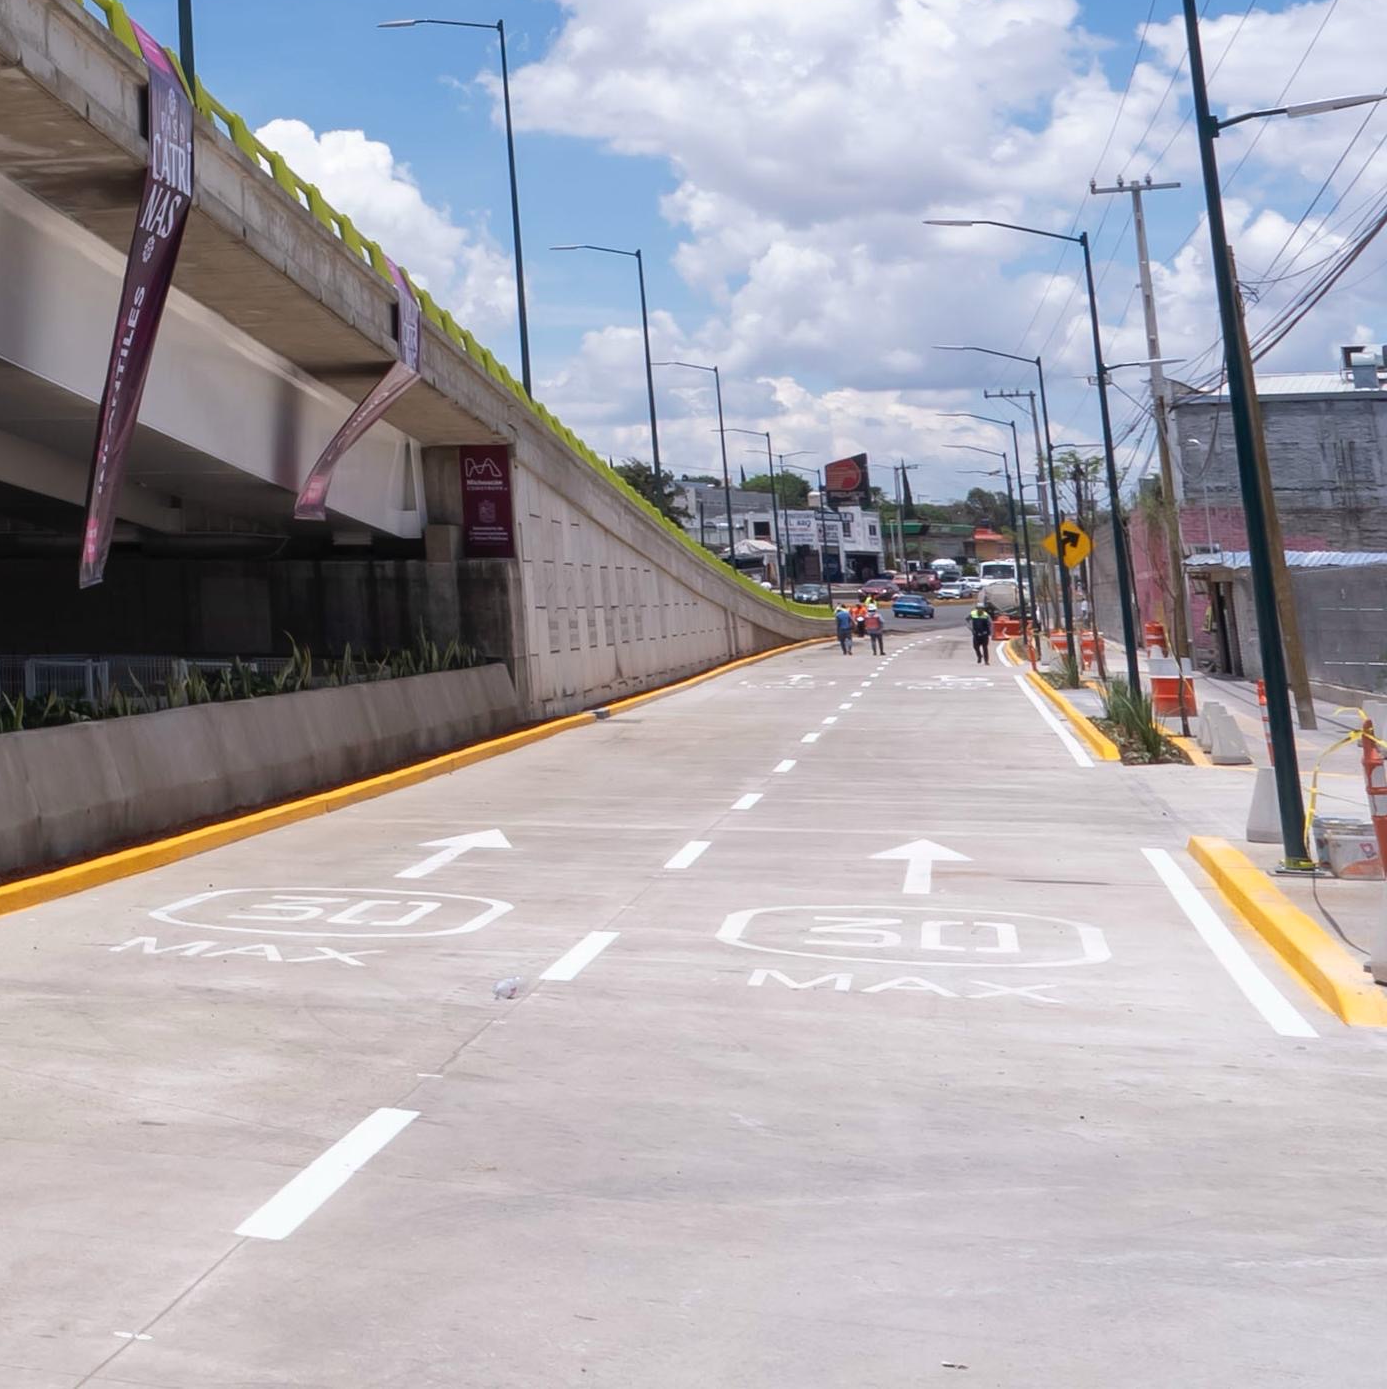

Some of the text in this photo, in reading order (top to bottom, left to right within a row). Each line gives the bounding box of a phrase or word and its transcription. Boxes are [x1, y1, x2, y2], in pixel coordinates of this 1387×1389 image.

[140, 184, 182, 238] NAS
[227, 895, 442, 926] 30
[109, 936, 387, 967] MAX
[804, 916, 1021, 953] 30
[746, 968, 1070, 1004] MAX
